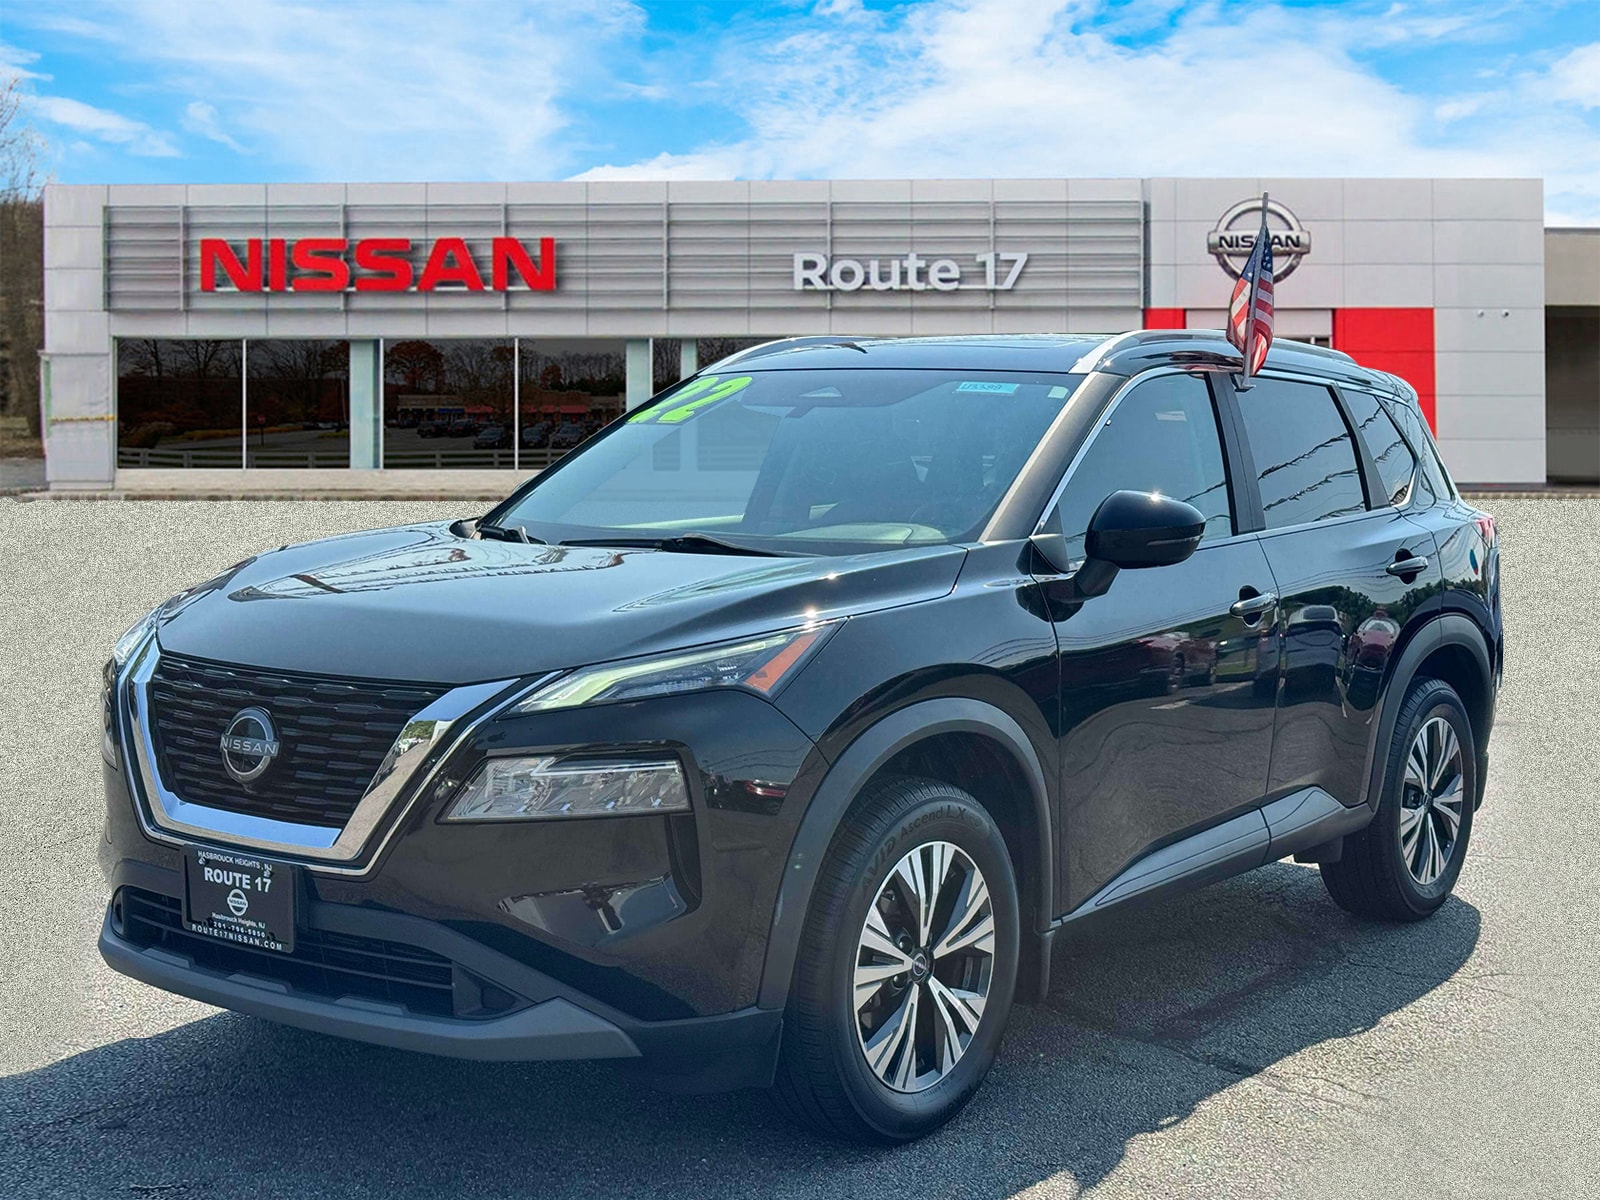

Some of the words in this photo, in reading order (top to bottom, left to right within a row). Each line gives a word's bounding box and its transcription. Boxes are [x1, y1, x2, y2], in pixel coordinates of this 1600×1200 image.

[1219, 235, 1300, 249] NISAN
[200, 237, 556, 292] NISSAN
[793, 251, 961, 292] Route
[975, 251, 1029, 290] 17
[221, 736, 276, 754] NISSAN
[900, 806, 944, 838] Ascend
[945, 804, 967, 821] LX
[197, 850, 234, 864] HASBROUCK
[264, 863, 272, 871] NJ
[204, 867, 251, 889] ROUTE
[255, 877, 272, 893] 17
[191, 923, 282, 951] ROUTE17NISSAN.COM
